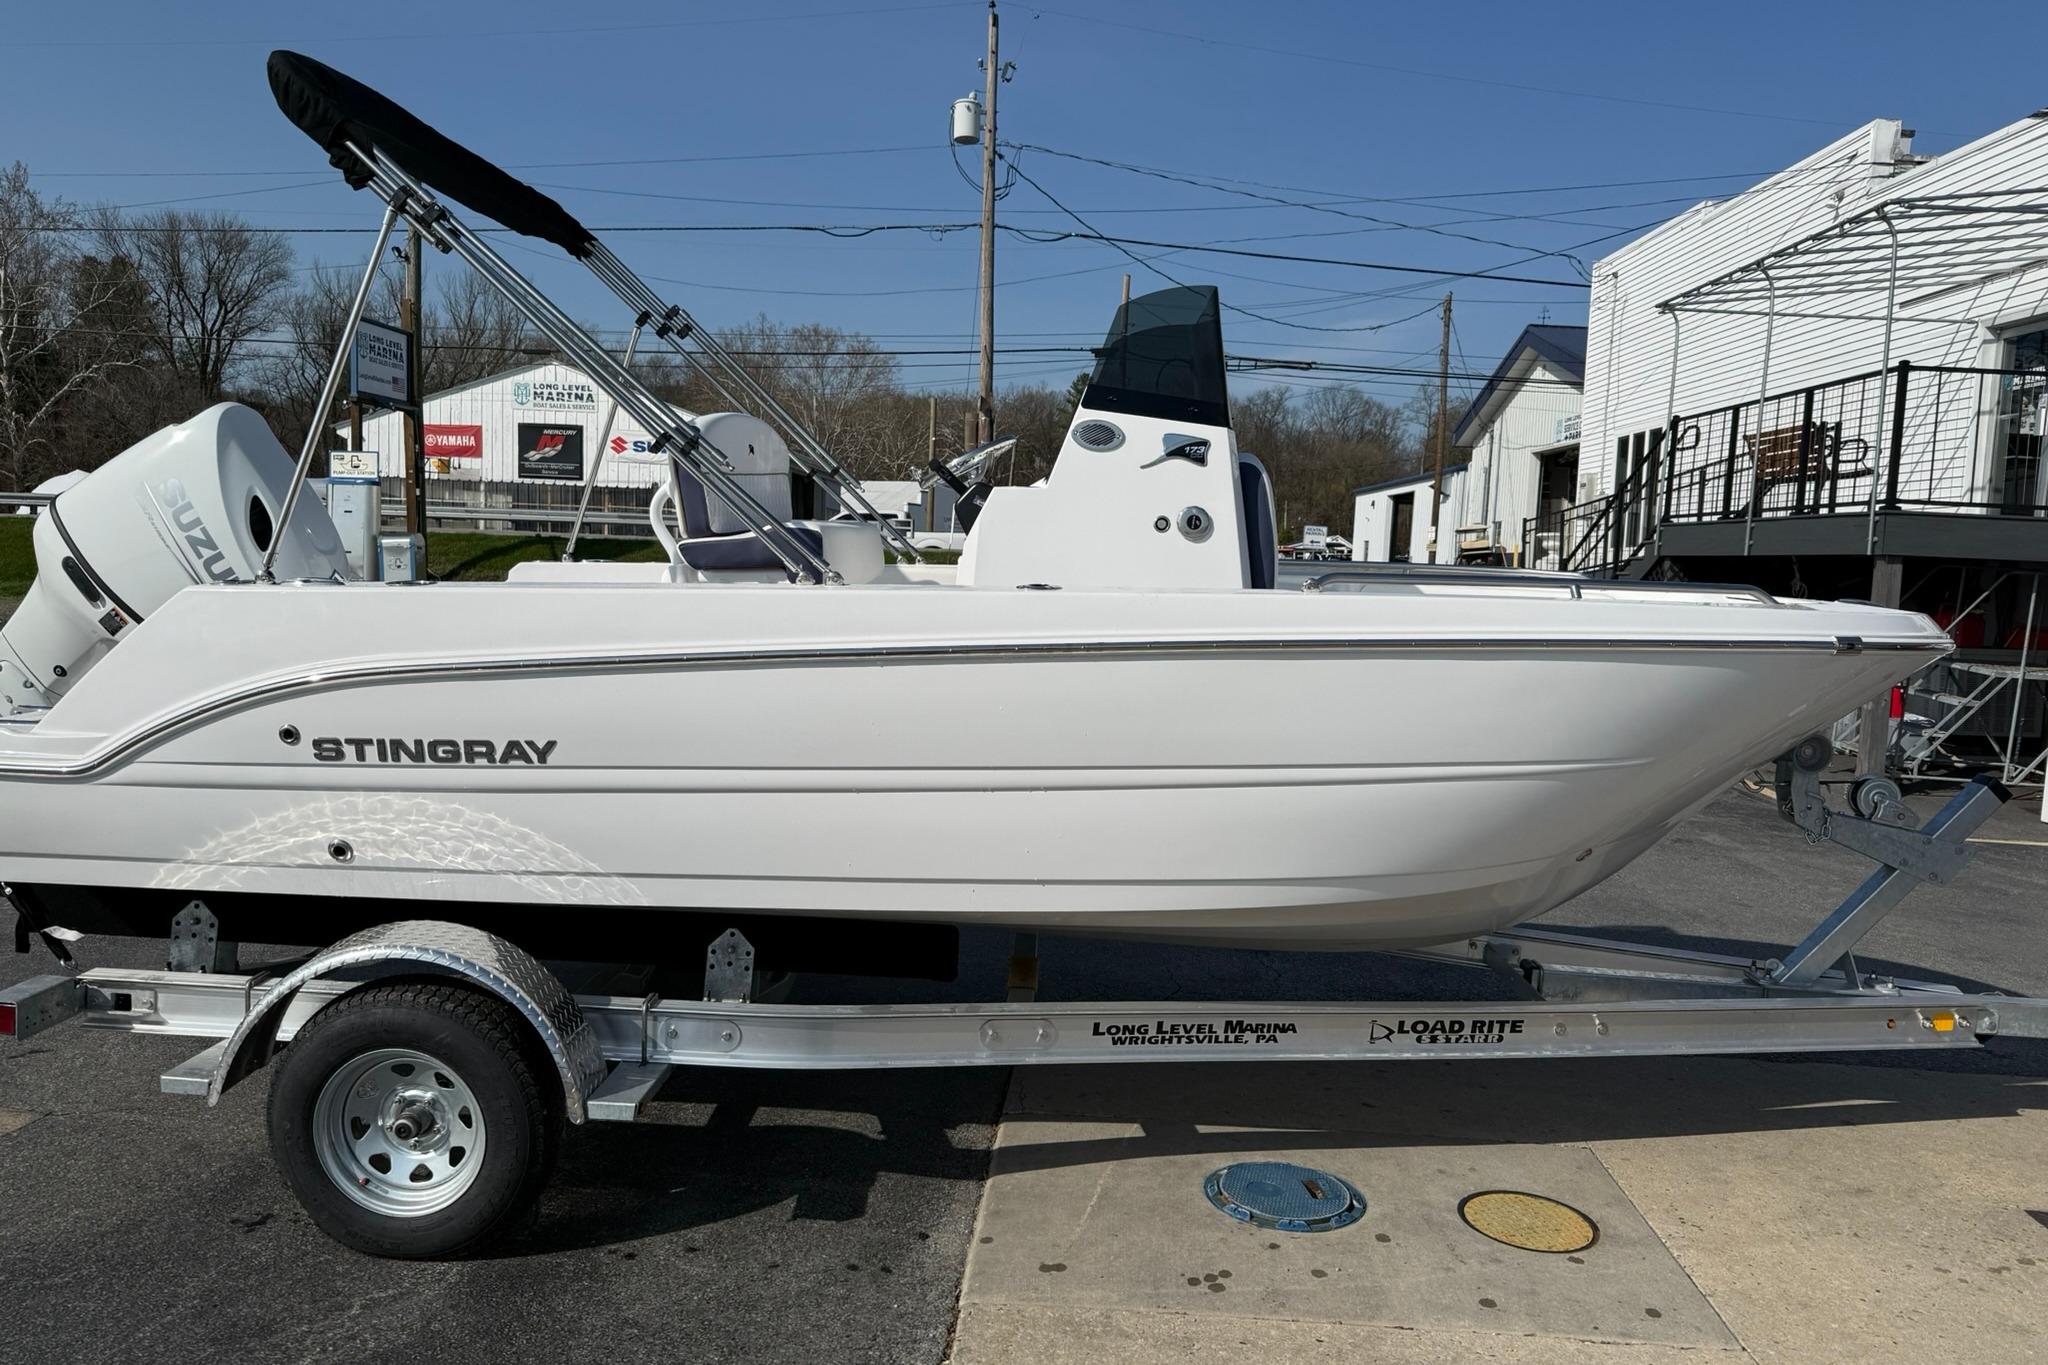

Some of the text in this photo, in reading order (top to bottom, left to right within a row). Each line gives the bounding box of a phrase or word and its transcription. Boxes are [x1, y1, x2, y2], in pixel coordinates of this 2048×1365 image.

[385, 338, 403, 351] LEVEL
[368, 343, 404, 364] MARINA
[533, 383, 593, 392] LONG LEVEL
[533, 391, 595, 403] MARINA
[436, 434, 476, 447] YAMAHA
[1184, 445, 1206, 454] 173
[160, 478, 241, 583] SUZU
[312, 737, 558, 765] STINGRAY
[1397, 1019, 1525, 1034] LOAD RITE
[1111, 1034, 1279, 1046] WRIGHTSVILLE, PA
